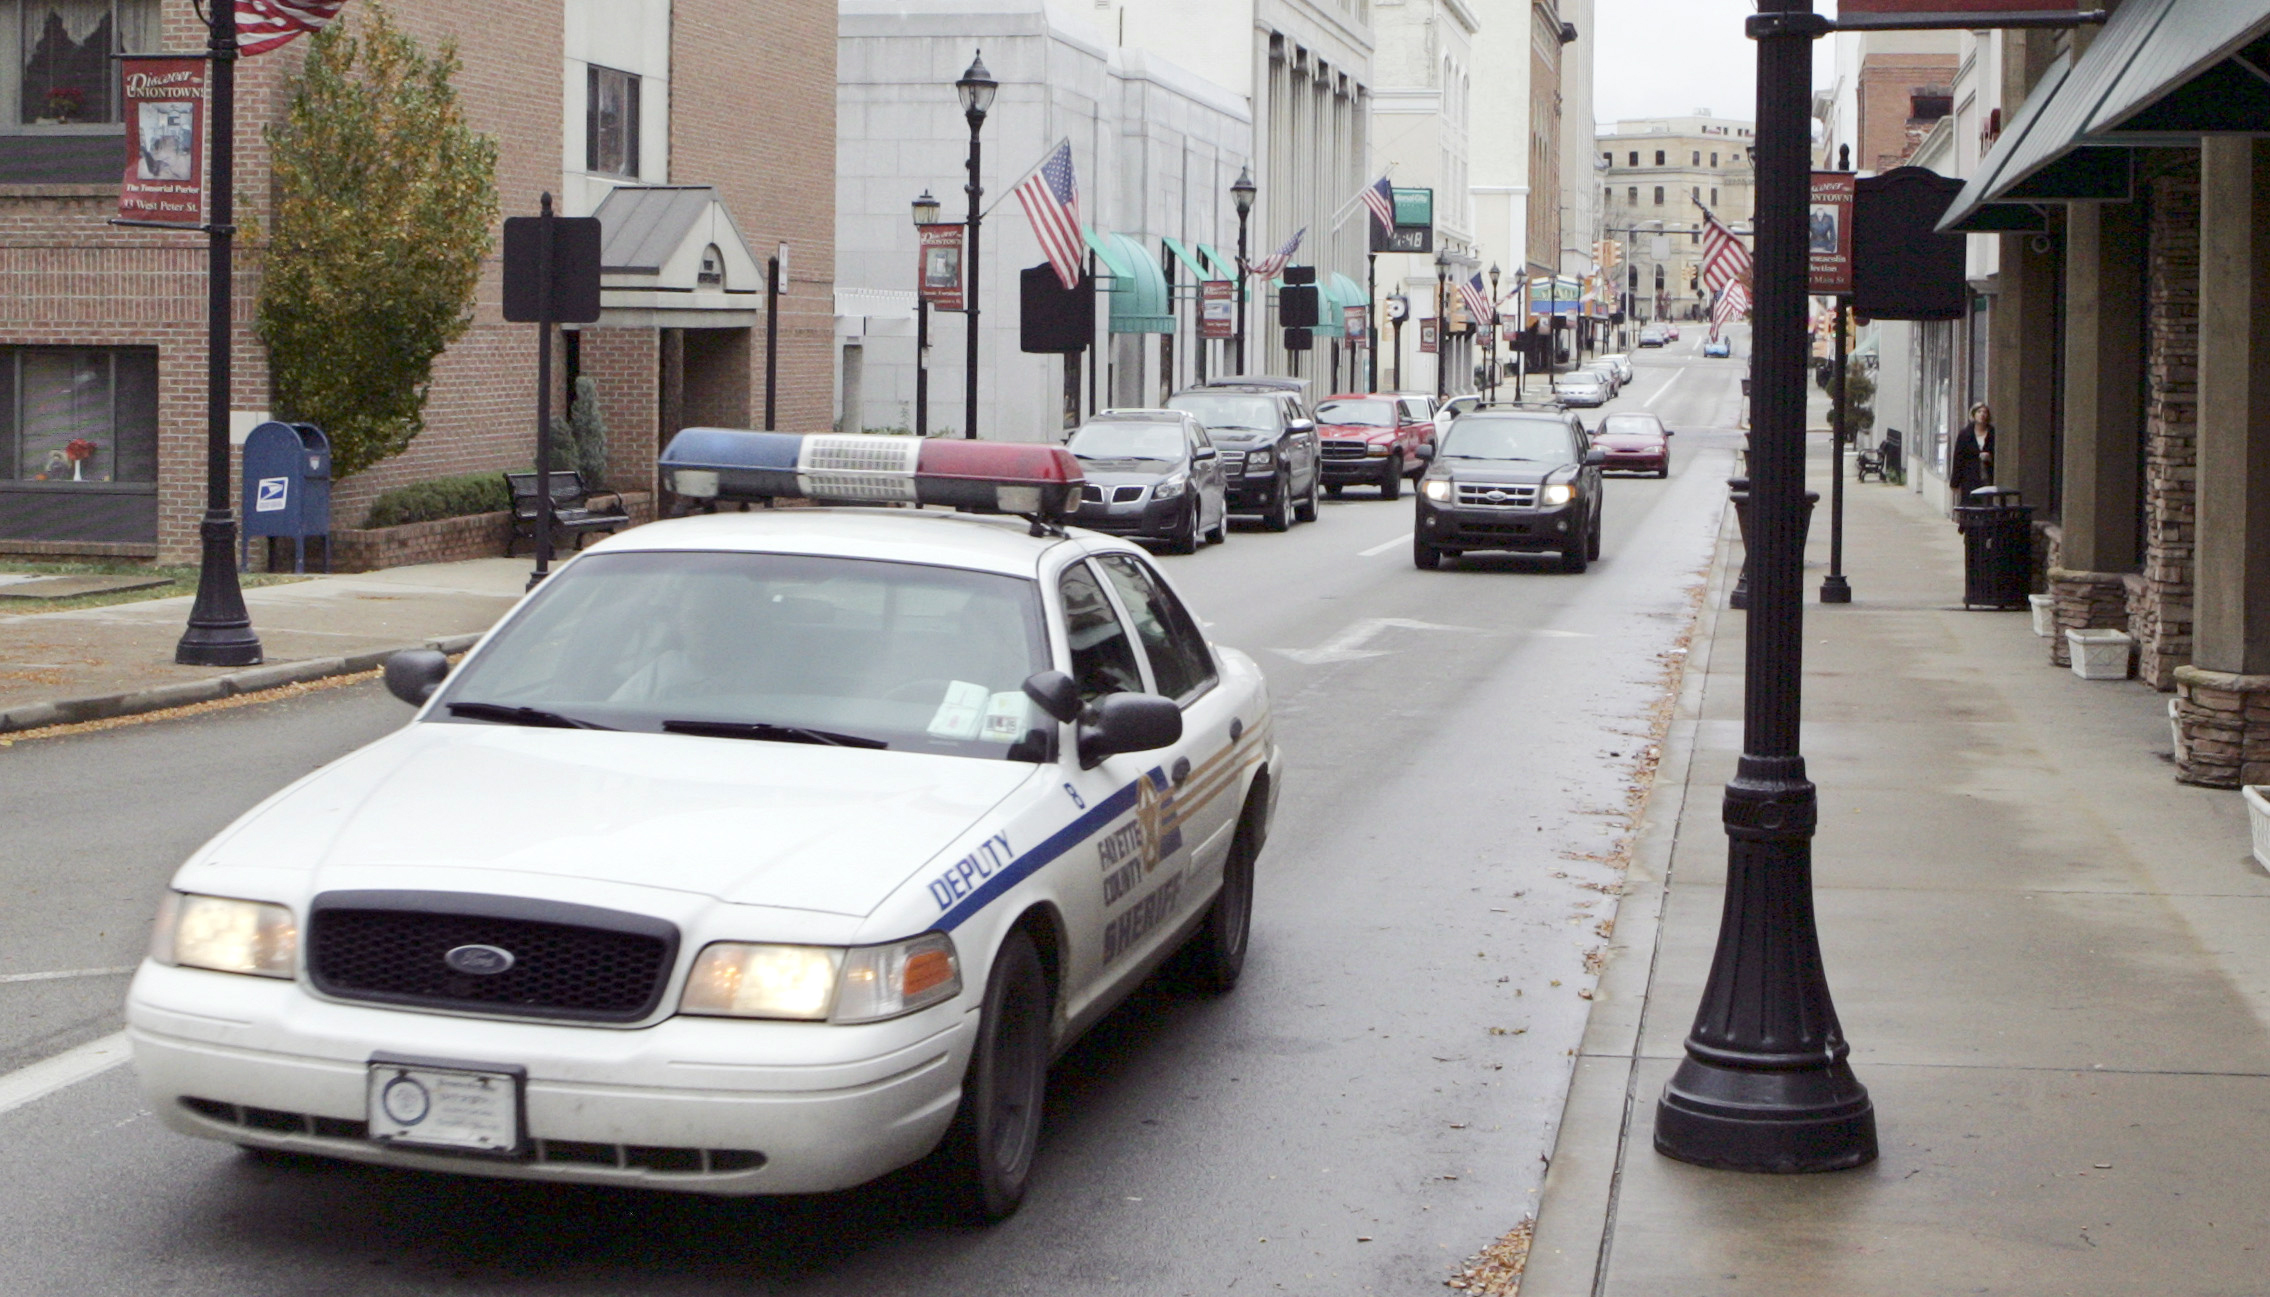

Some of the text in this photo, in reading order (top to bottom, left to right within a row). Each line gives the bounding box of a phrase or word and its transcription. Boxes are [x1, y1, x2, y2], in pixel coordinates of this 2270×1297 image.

[127, 71, 193, 91] Discover
[136, 200, 158, 210] West
[160, 201, 184, 212] Peter
[928, 828, 1014, 911] DEPUTY
[1098, 818, 1144, 872] FAYETTE
[1103, 856, 1142, 908] COUNTY
[1102, 868, 1184, 967] SHERIFF
